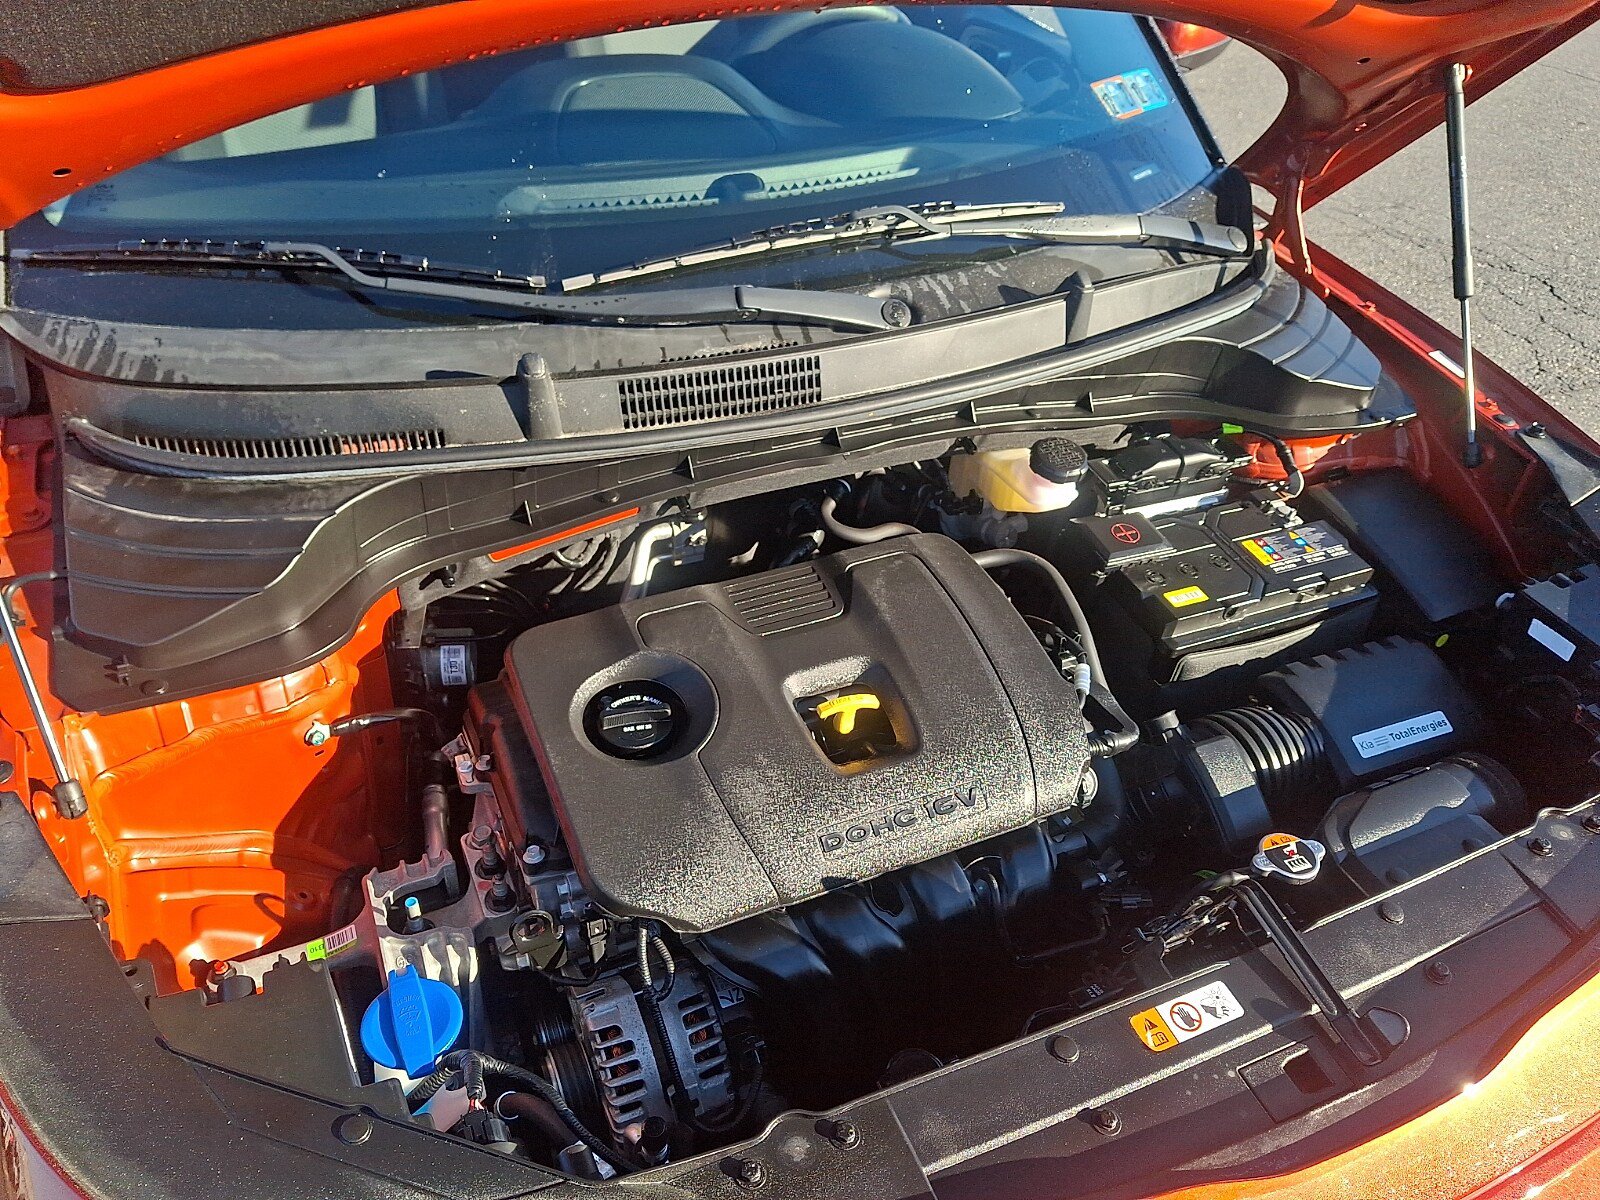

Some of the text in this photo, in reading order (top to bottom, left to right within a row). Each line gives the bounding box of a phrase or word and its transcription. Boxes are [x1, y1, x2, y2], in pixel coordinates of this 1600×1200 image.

[1359, 719, 1448, 751] Kia TotalEnergies
[819, 787, 977, 853] DOHC 16V
